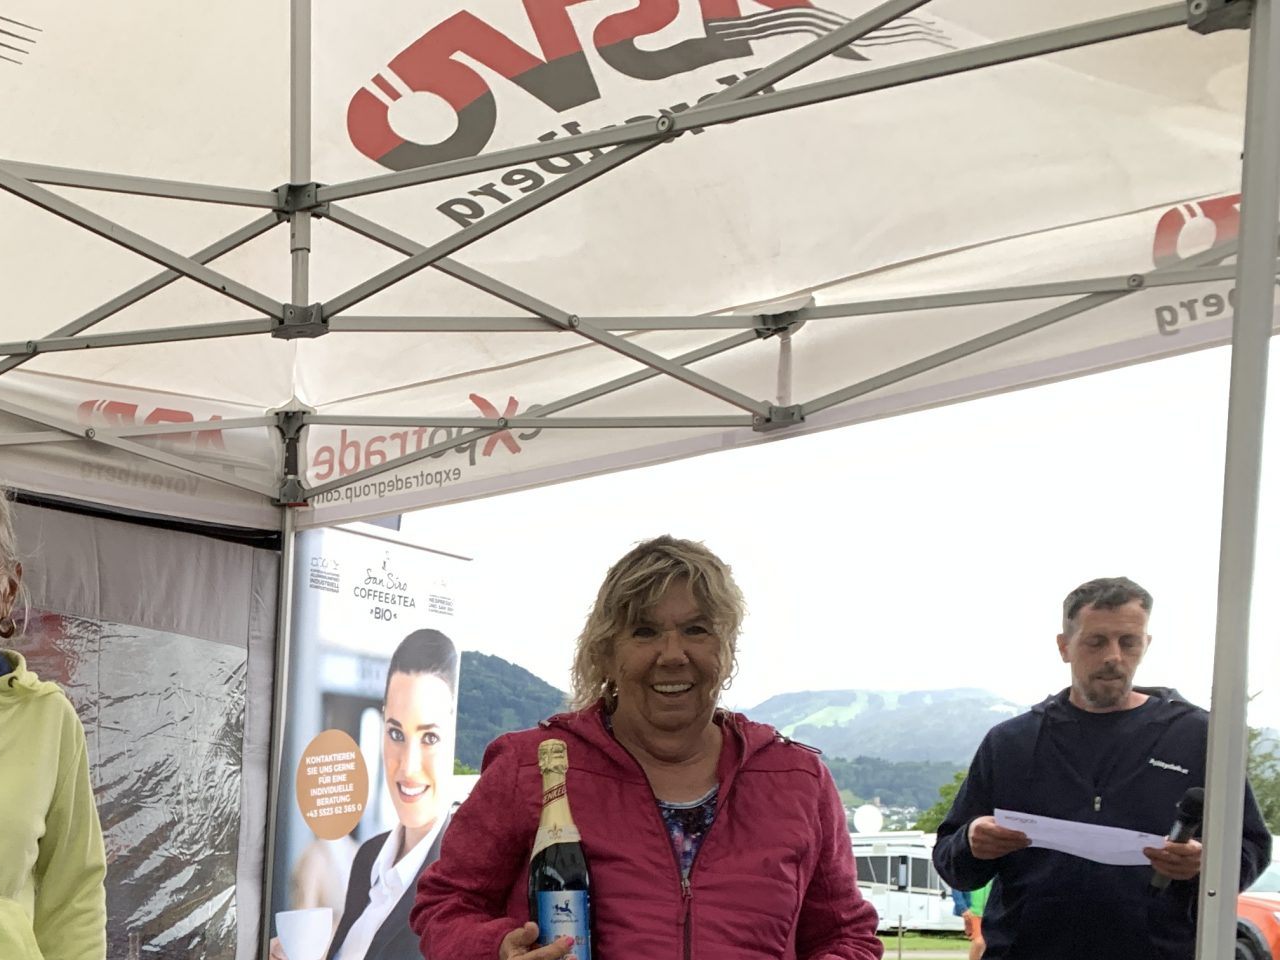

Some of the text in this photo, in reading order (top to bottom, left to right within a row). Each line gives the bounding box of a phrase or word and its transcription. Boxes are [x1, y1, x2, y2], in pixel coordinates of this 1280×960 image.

[353, 586, 416, 608] COFFEE&TEA
[305, 752, 356, 765] KONTAKTIEREN
[306, 762, 356, 775] SIE UNS GERNE
[318, 773, 348, 784] FÜR EINE
[310, 783, 354, 797] INDIVIDUELLE
